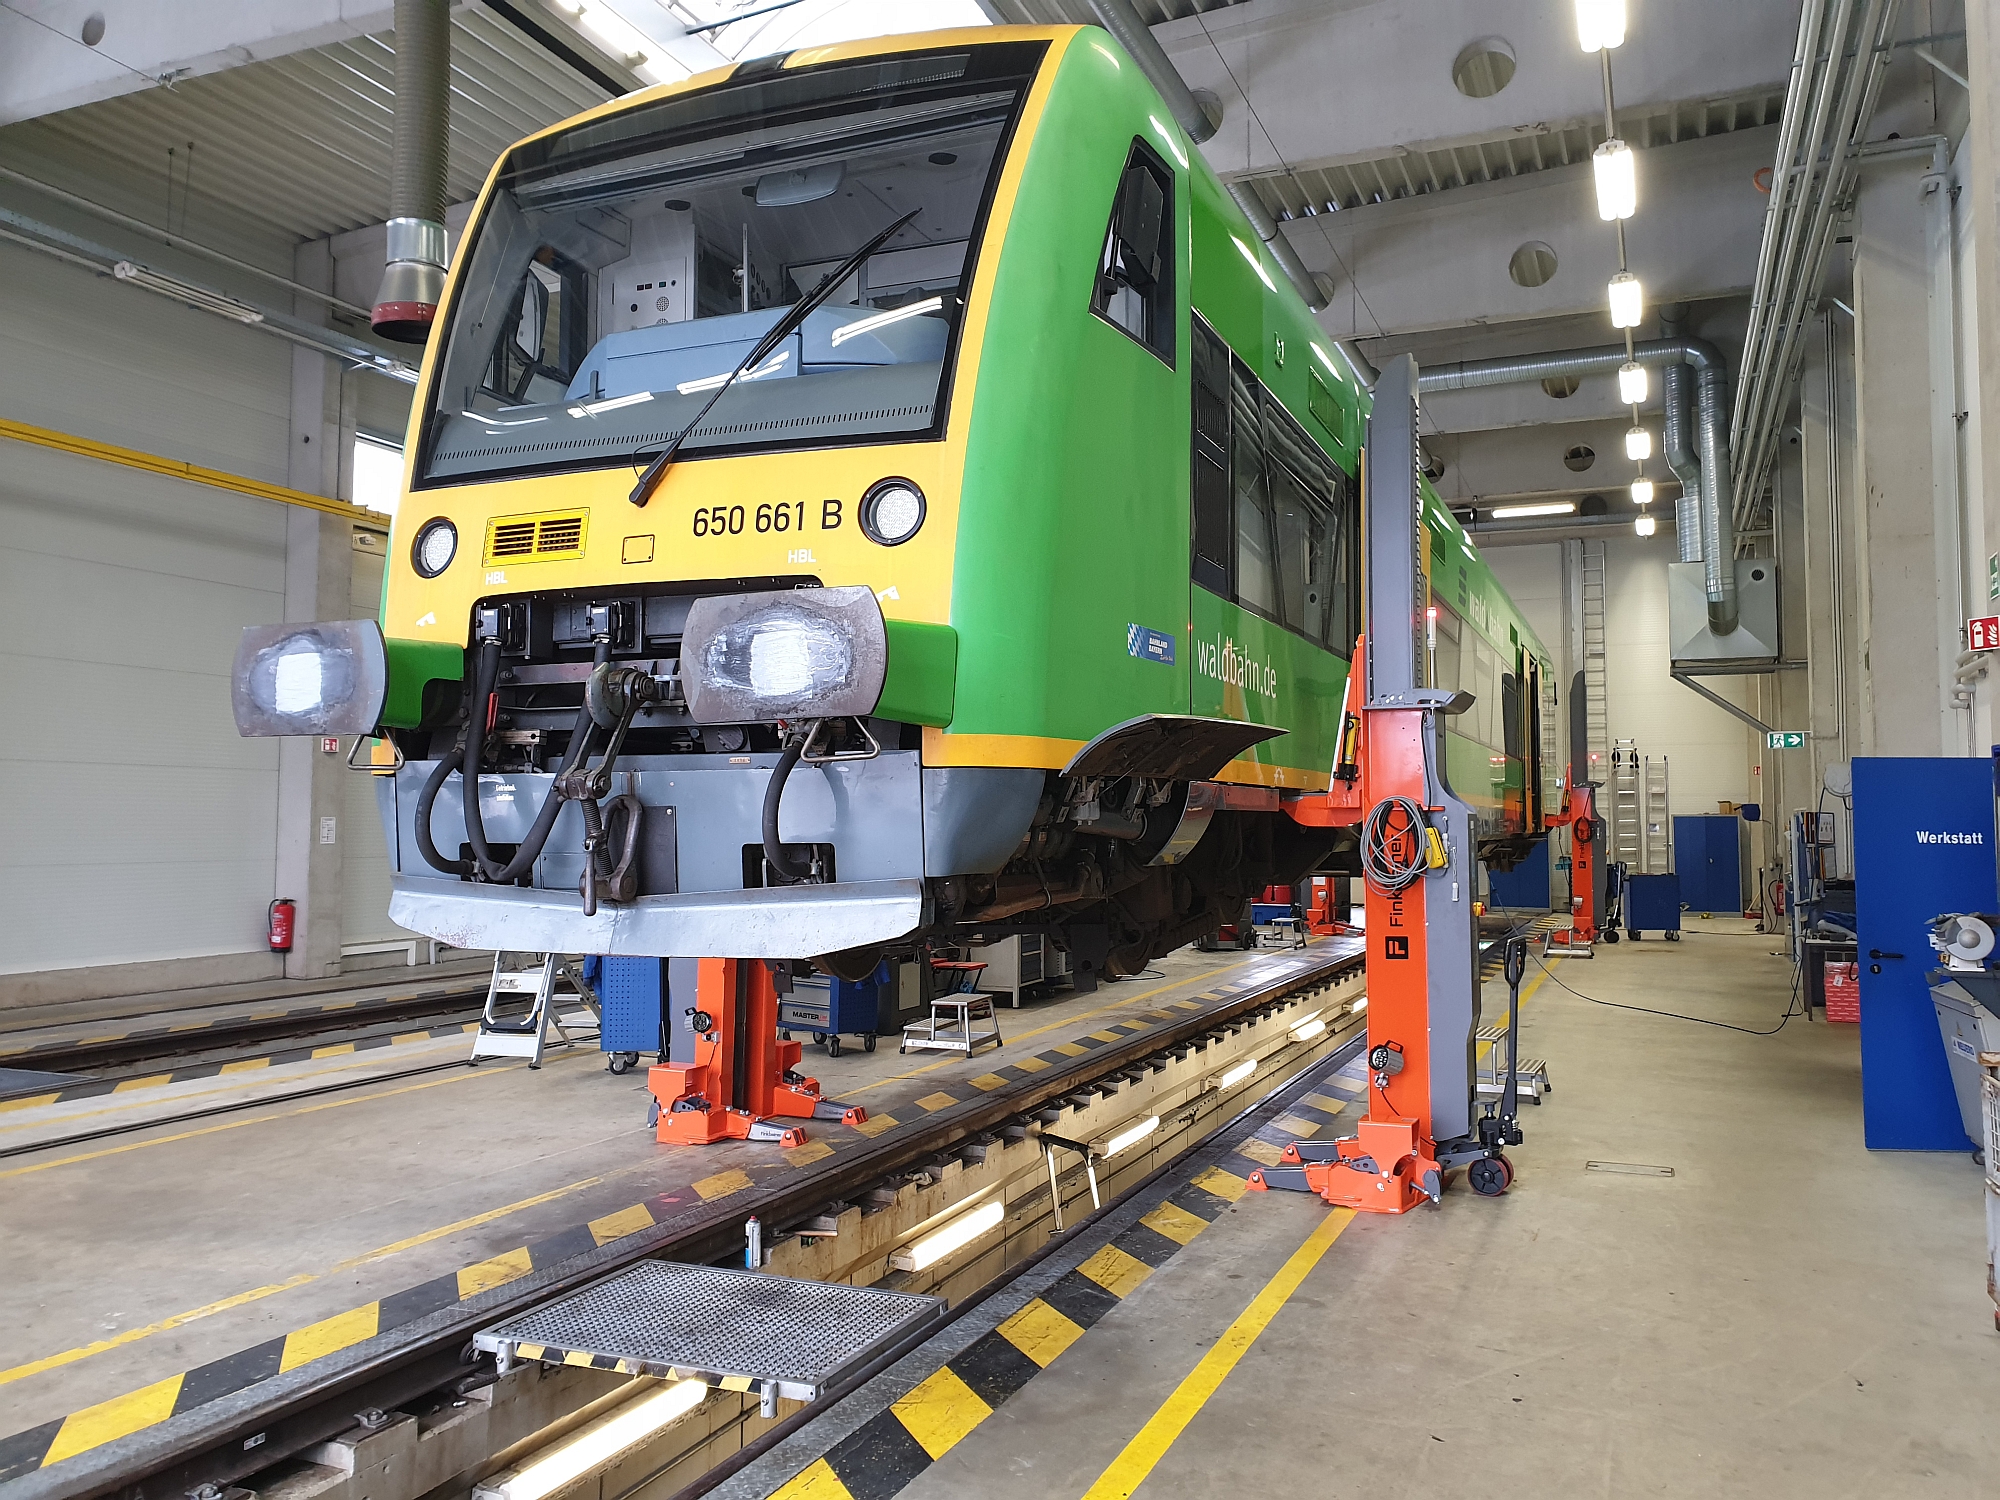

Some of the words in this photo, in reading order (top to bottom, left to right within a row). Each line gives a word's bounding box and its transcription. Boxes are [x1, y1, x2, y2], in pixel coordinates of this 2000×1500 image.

[692, 505, 745, 537] 650
[755, 500, 804, 533] 661
[821, 499, 843, 530] B
[787, 548, 816, 564] HBL
[485, 570, 508, 586] HBL
[1197, 632, 1277, 699] waldbahn.de
[1916, 831, 1983, 844] Werkstatt
